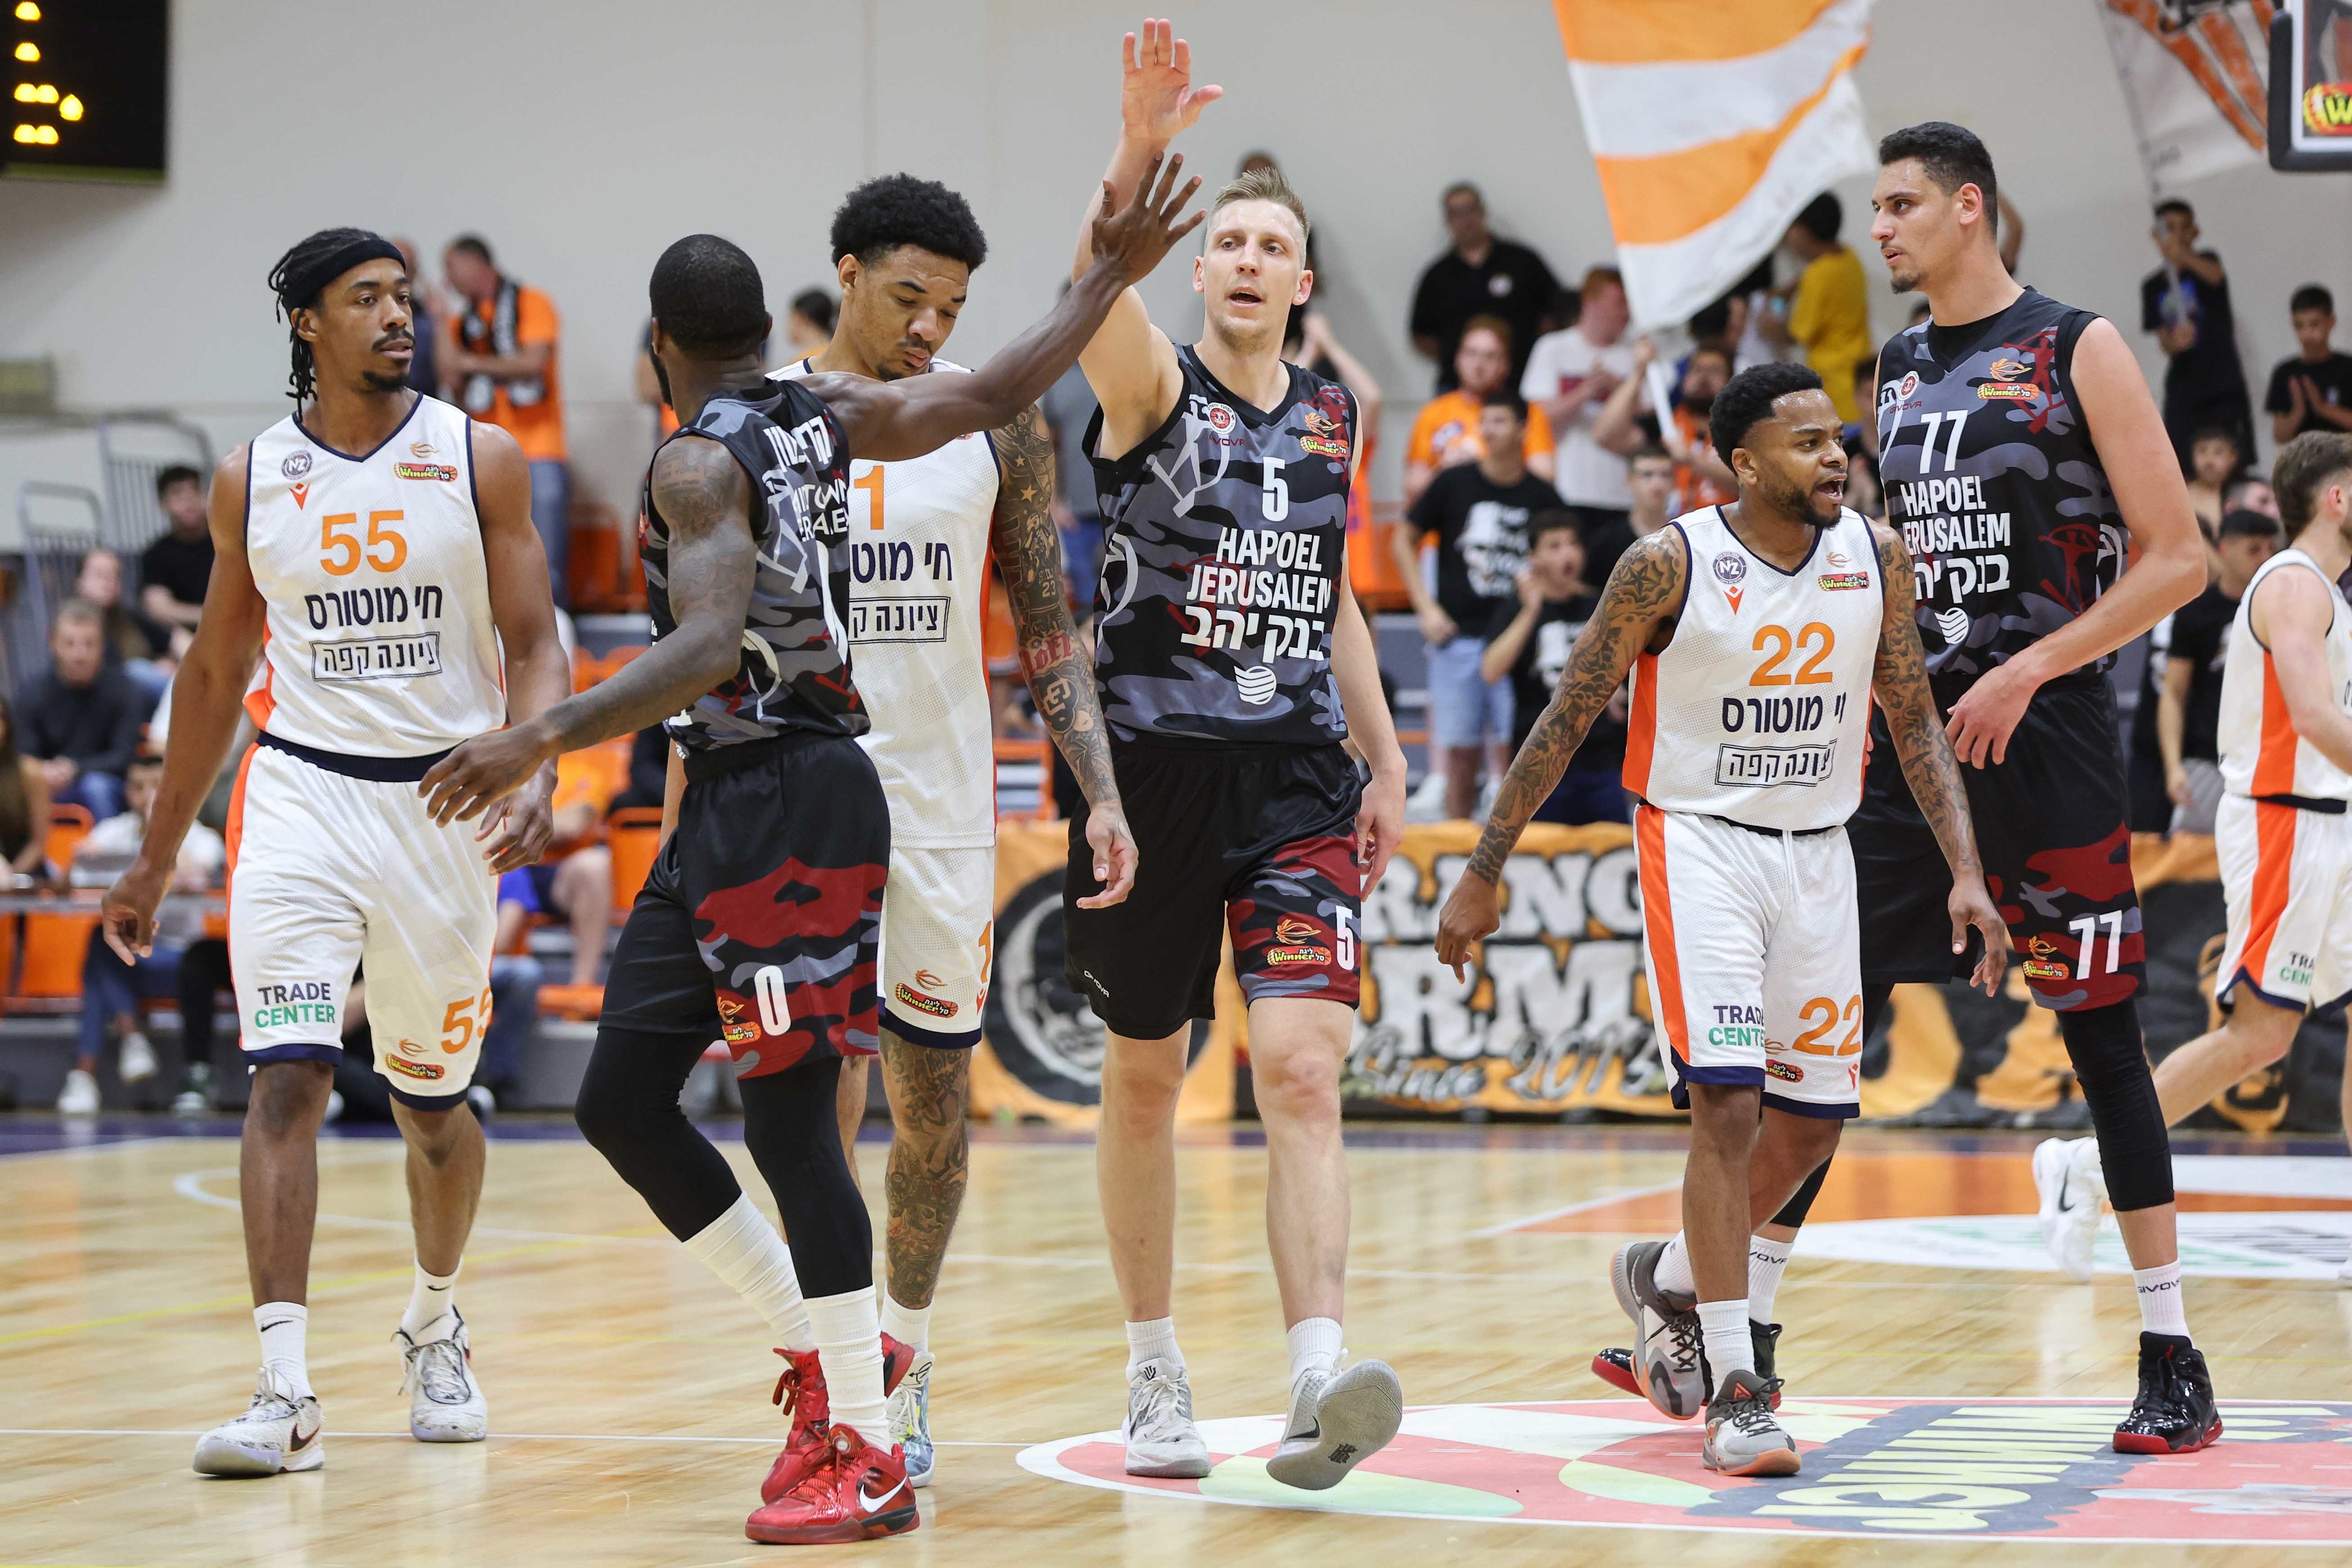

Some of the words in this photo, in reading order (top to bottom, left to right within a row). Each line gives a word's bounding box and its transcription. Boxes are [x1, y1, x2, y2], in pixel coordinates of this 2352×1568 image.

[2323, 95, 2352, 125] W
[1984, 387, 2020, 396] Winner
[1307, 440, 1339, 454] Winner
[1919, 410, 1969, 474] 77
[399, 467, 439, 477] Winner
[1262, 456, 1288, 522] 5
[854, 465, 884, 530] 1
[1900, 475, 1987, 517] HAPOEL
[320, 510, 407, 576] 55
[849, 541, 914, 583] מוט
[924, 542, 953, 581] חי
[1215, 527, 1322, 572] HAPOEL
[1719, 560, 1740, 575] NZ
[1823, 579, 1859, 589] Winner
[1914, 560, 1942, 600] יה
[1946, 554, 2010, 604] בנק
[304, 587, 409, 630] מוטורס
[415, 585, 443, 619] חי
[1186, 564, 1332, 614] JERUSALEM
[876, 606, 938, 631] ציונה
[1180, 605, 1260, 650] יהב
[1262, 614, 1325, 664] בנק
[1749, 621, 1835, 687] 22
[323, 647, 369, 674] קפה
[1722, 696, 1823, 733] מוטורס
[1729, 753, 1780, 783] קפה
[978, 920, 992, 984] 1
[1274, 951, 1315, 962] Winner
[1315, 952, 1325, 961] סל
[1335, 905, 1355, 971] 5
[2069, 909, 2123, 981] 77
[2280, 966, 2313, 987] CEN
[2288, 951, 2315, 970] TRA
[258, 982, 332, 1005] TRADE
[754, 965, 791, 1037] 0
[900, 988, 940, 1012] Winner
[940, 1006, 950, 1015] סל
[924, 999, 940, 1007] ליגת
[1369, 940, 1646, 1058] RM
[254, 1004, 336, 1028] CENTER
[1792, 994, 1862, 1057] 22
[1708, 1027, 1766, 1047] CENTE
